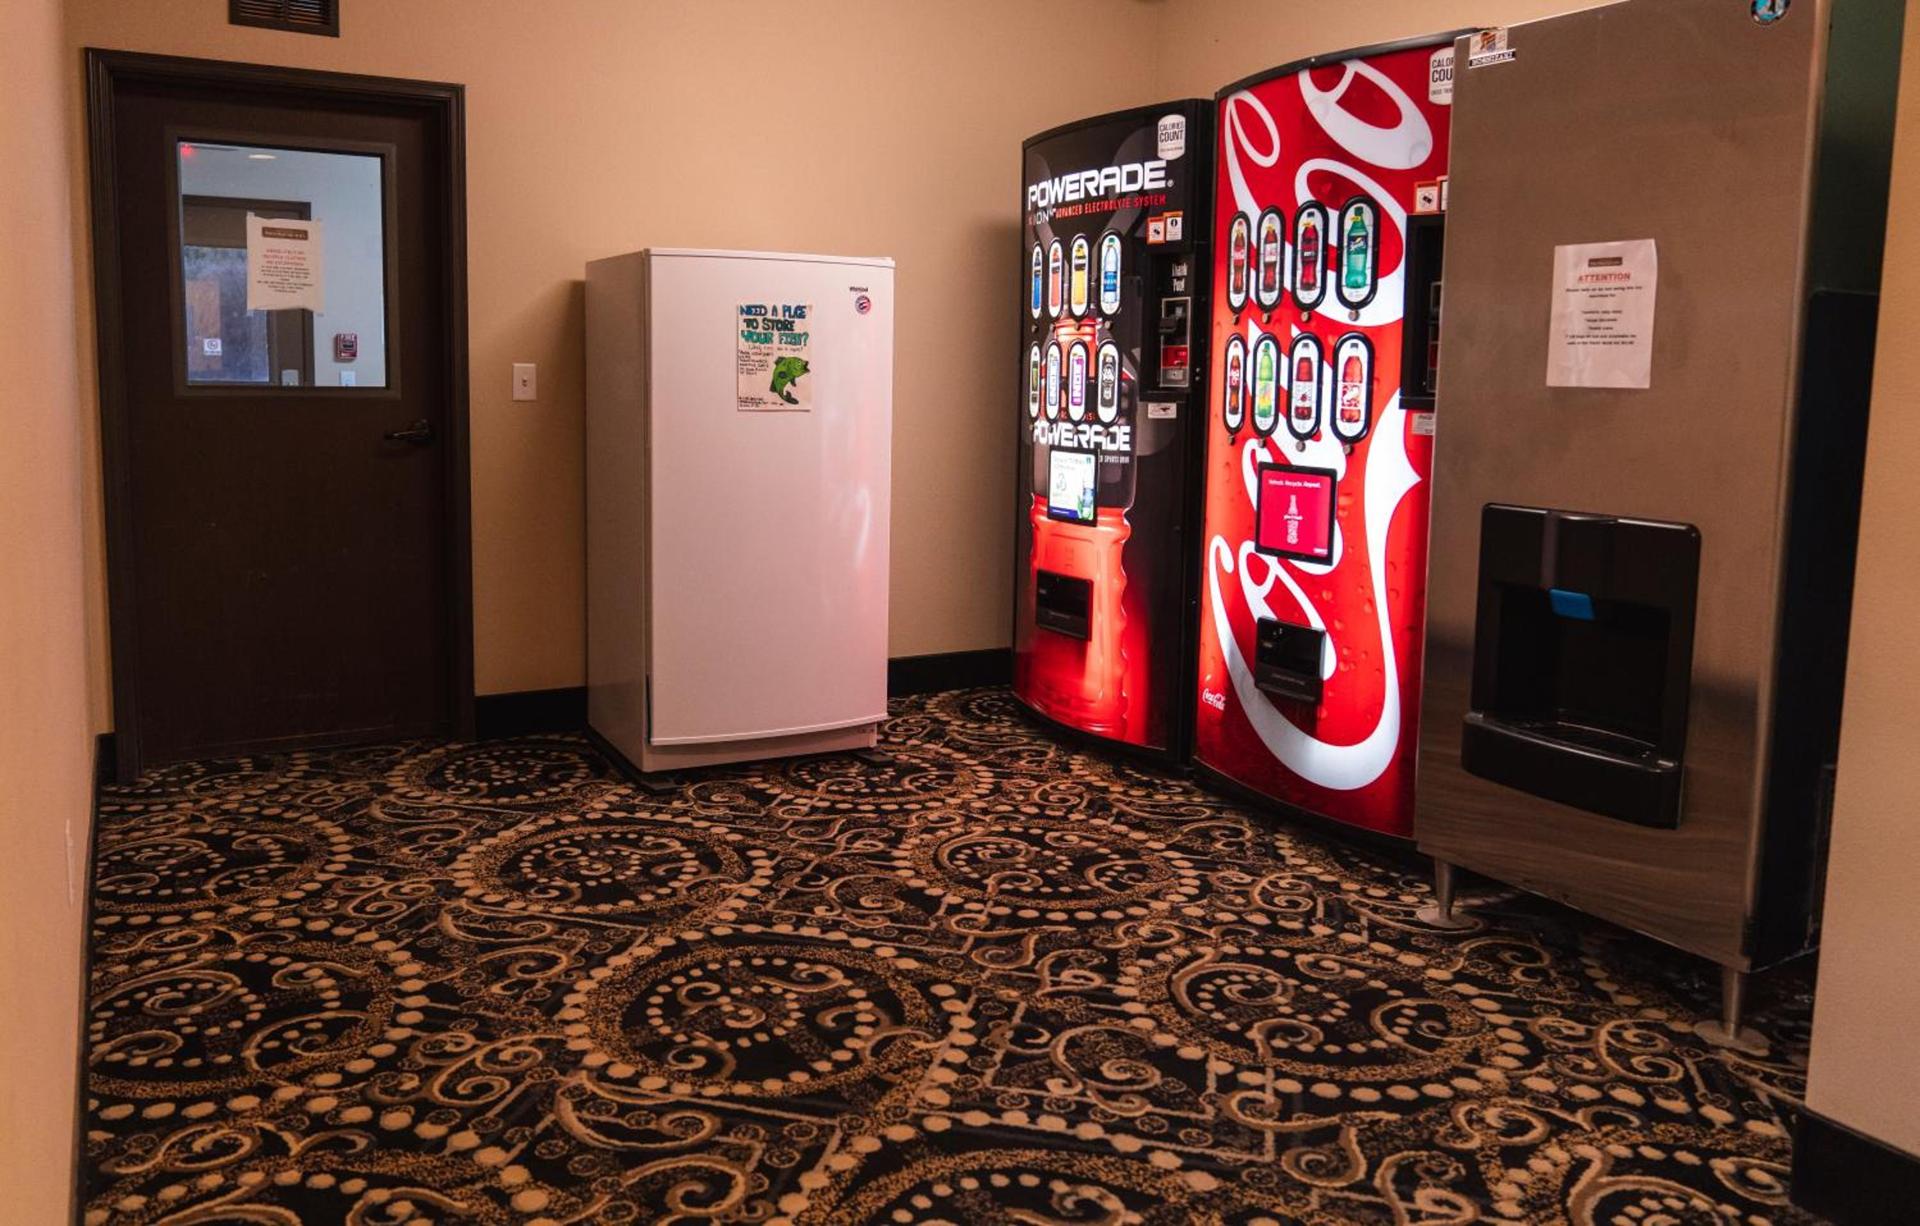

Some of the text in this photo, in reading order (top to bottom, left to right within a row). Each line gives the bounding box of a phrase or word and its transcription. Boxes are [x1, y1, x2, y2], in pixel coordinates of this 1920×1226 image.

[1160, 129, 1184, 143] COUNT
[1028, 160, 1167, 211] POWERADE
[1578, 272, 1631, 283] ATTENTION
[740, 304, 768, 316] NEED
[771, 304, 778, 318] A
[743, 318, 795, 332] TO STORE
[1033, 420, 1131, 451] POWERADE
